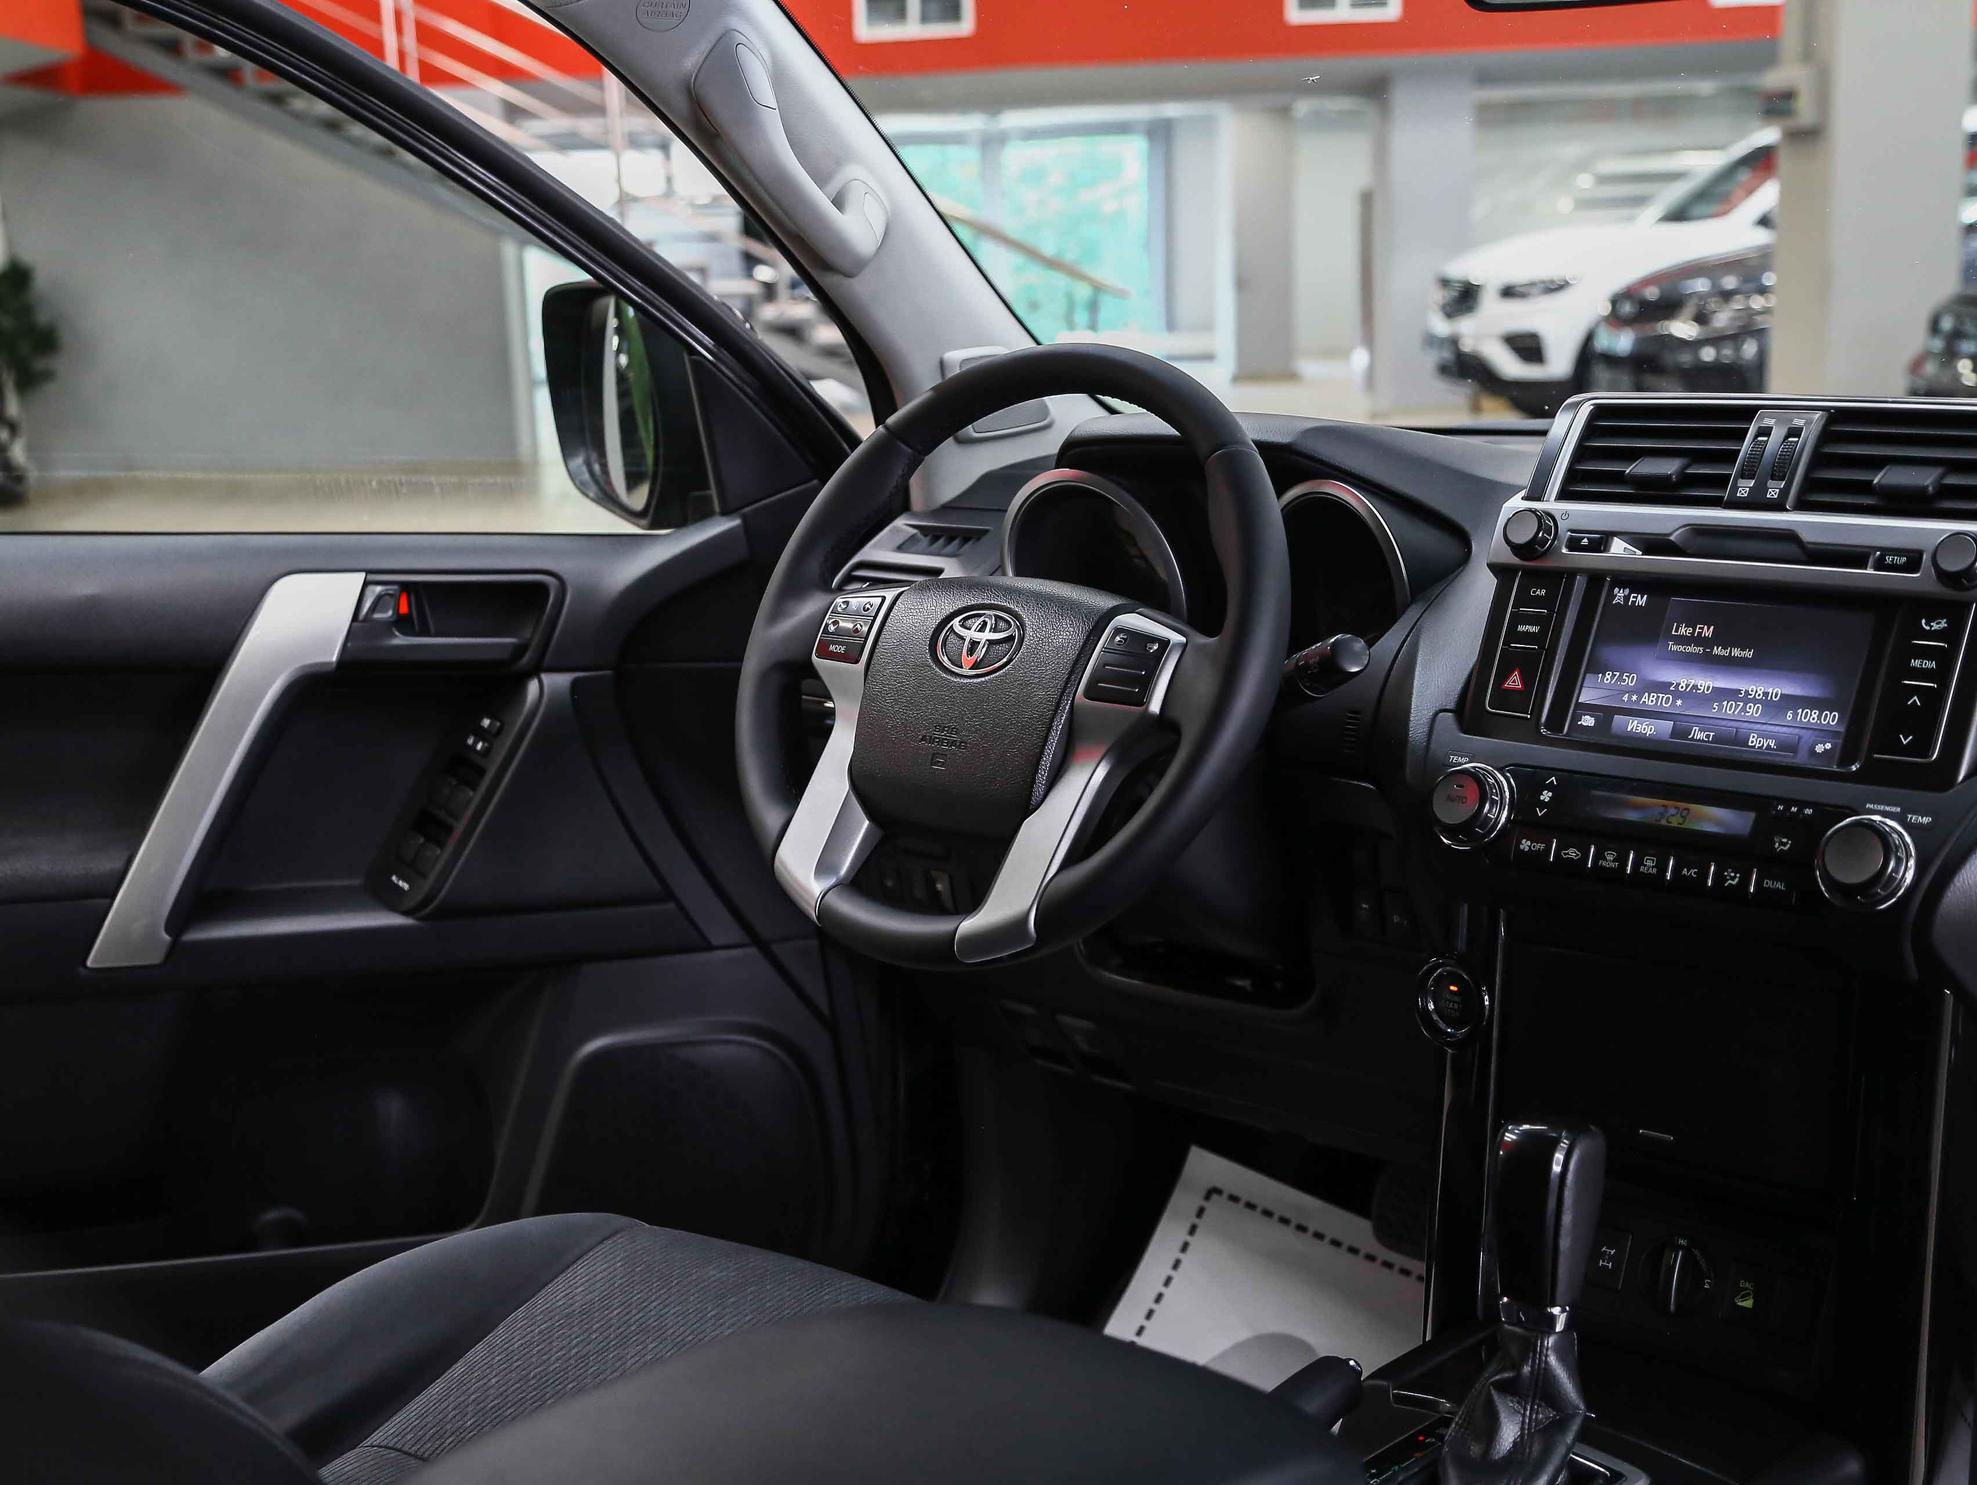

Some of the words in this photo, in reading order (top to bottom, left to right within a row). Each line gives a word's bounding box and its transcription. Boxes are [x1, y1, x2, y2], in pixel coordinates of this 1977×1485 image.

[1884, 555, 1907, 565] SETUP
[1530, 588, 1546, 597] CAR
[1628, 594, 1647, 607] FM
[1672, 623, 1692, 637] Like
[1695, 624, 1714, 638] FM
[828, 644, 846, 653] MODE
[1667, 642, 1703, 654] Twocolors
[1713, 646, 1730, 657] Mad
[1731, 649, 1754, 659] World
[1910, 659, 1936, 669] MEDIA
[1604, 671, 1637, 686] 87.50
[1678, 679, 1713, 694] 87.90
[1747, 686, 1781, 701] 98.10
[1721, 701, 1762, 717] 107.90
[1796, 709, 1839, 724] 108.00
[1627, 719, 1657, 736] Избр.
[1688, 727, 1715, 741] Лист
[1748, 733, 1777, 749] Вруч.
[1449, 756, 1469, 764] TEMP
[1866, 803, 1901, 813] PASSENGER
[1906, 814, 1932, 825] TEMP
[1530, 842, 1546, 853] OFF
[1598, 860, 1619, 869] FRONT
[1640, 865, 1658, 875] REAR
[1682, 867, 1699, 879] A/C
[1763, 878, 1786, 891] DUAL
